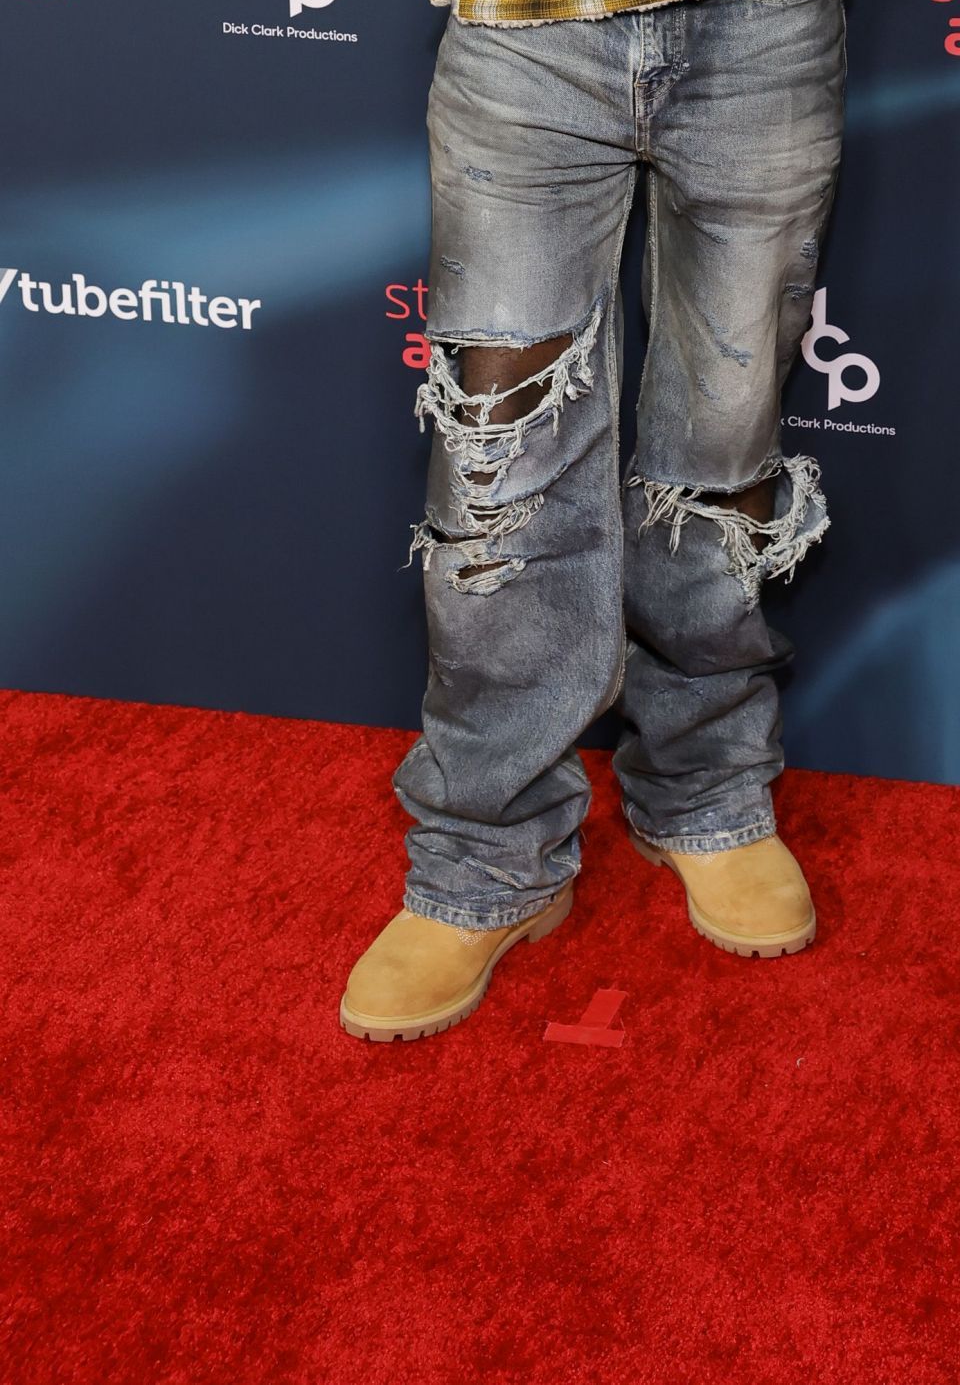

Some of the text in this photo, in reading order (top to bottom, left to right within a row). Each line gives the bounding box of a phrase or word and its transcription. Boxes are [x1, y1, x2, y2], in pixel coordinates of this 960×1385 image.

[222, 22, 358, 43] Dick Clark Productions
[17, 272, 262, 330] tubefilter
[787, 415, 821, 430] Clark
[824, 418, 897, 436] Productions
